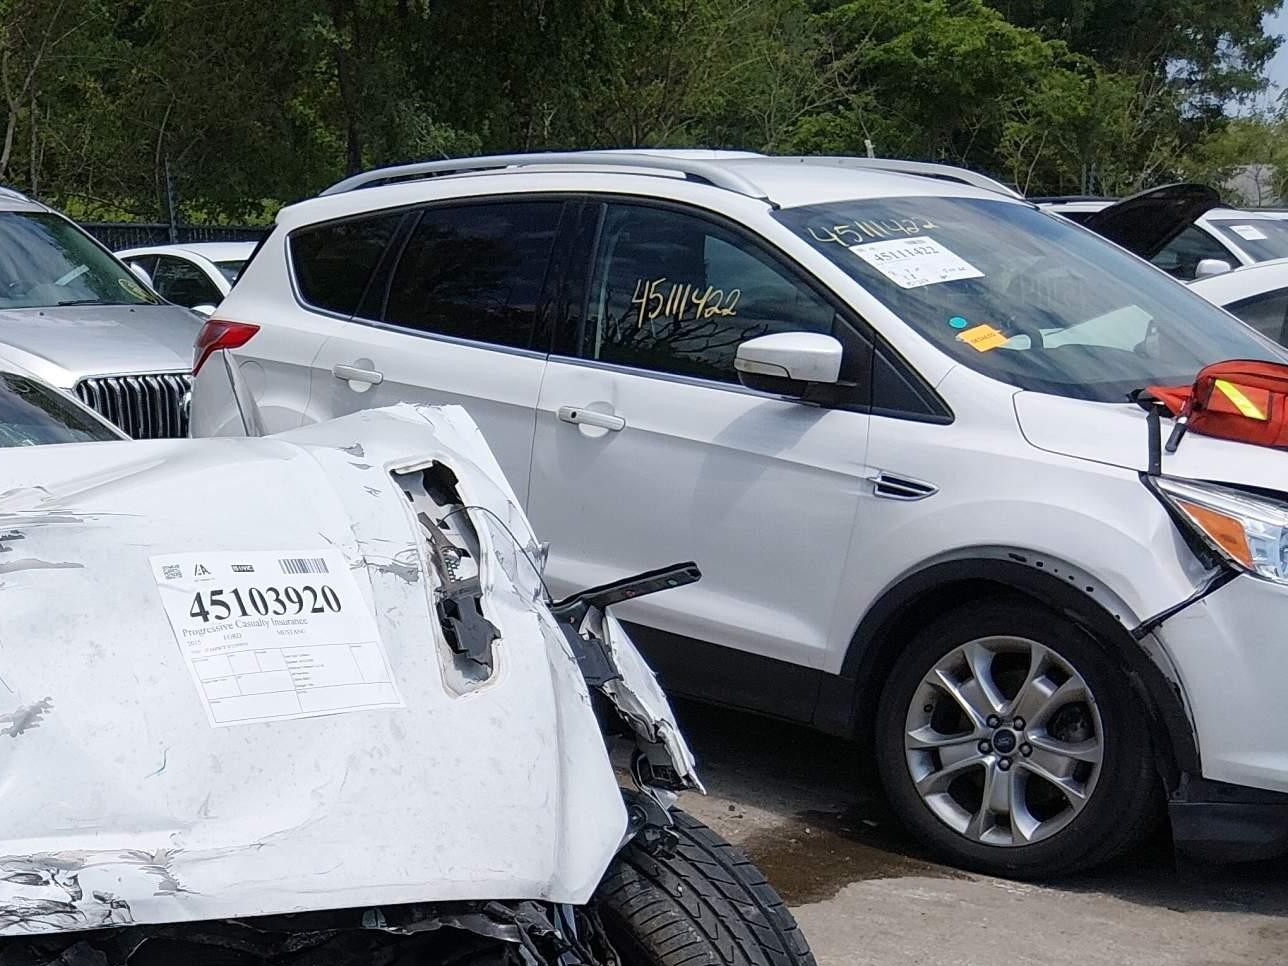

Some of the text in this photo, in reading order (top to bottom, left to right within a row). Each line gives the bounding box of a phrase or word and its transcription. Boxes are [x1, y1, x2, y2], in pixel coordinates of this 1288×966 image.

[873, 246, 940, 262] 45111422
[632, 278, 741, 328] 45111422
[189, 584, 342, 623] 45103920
[182, 617, 309, 638] Progressive Casualty Insurance
